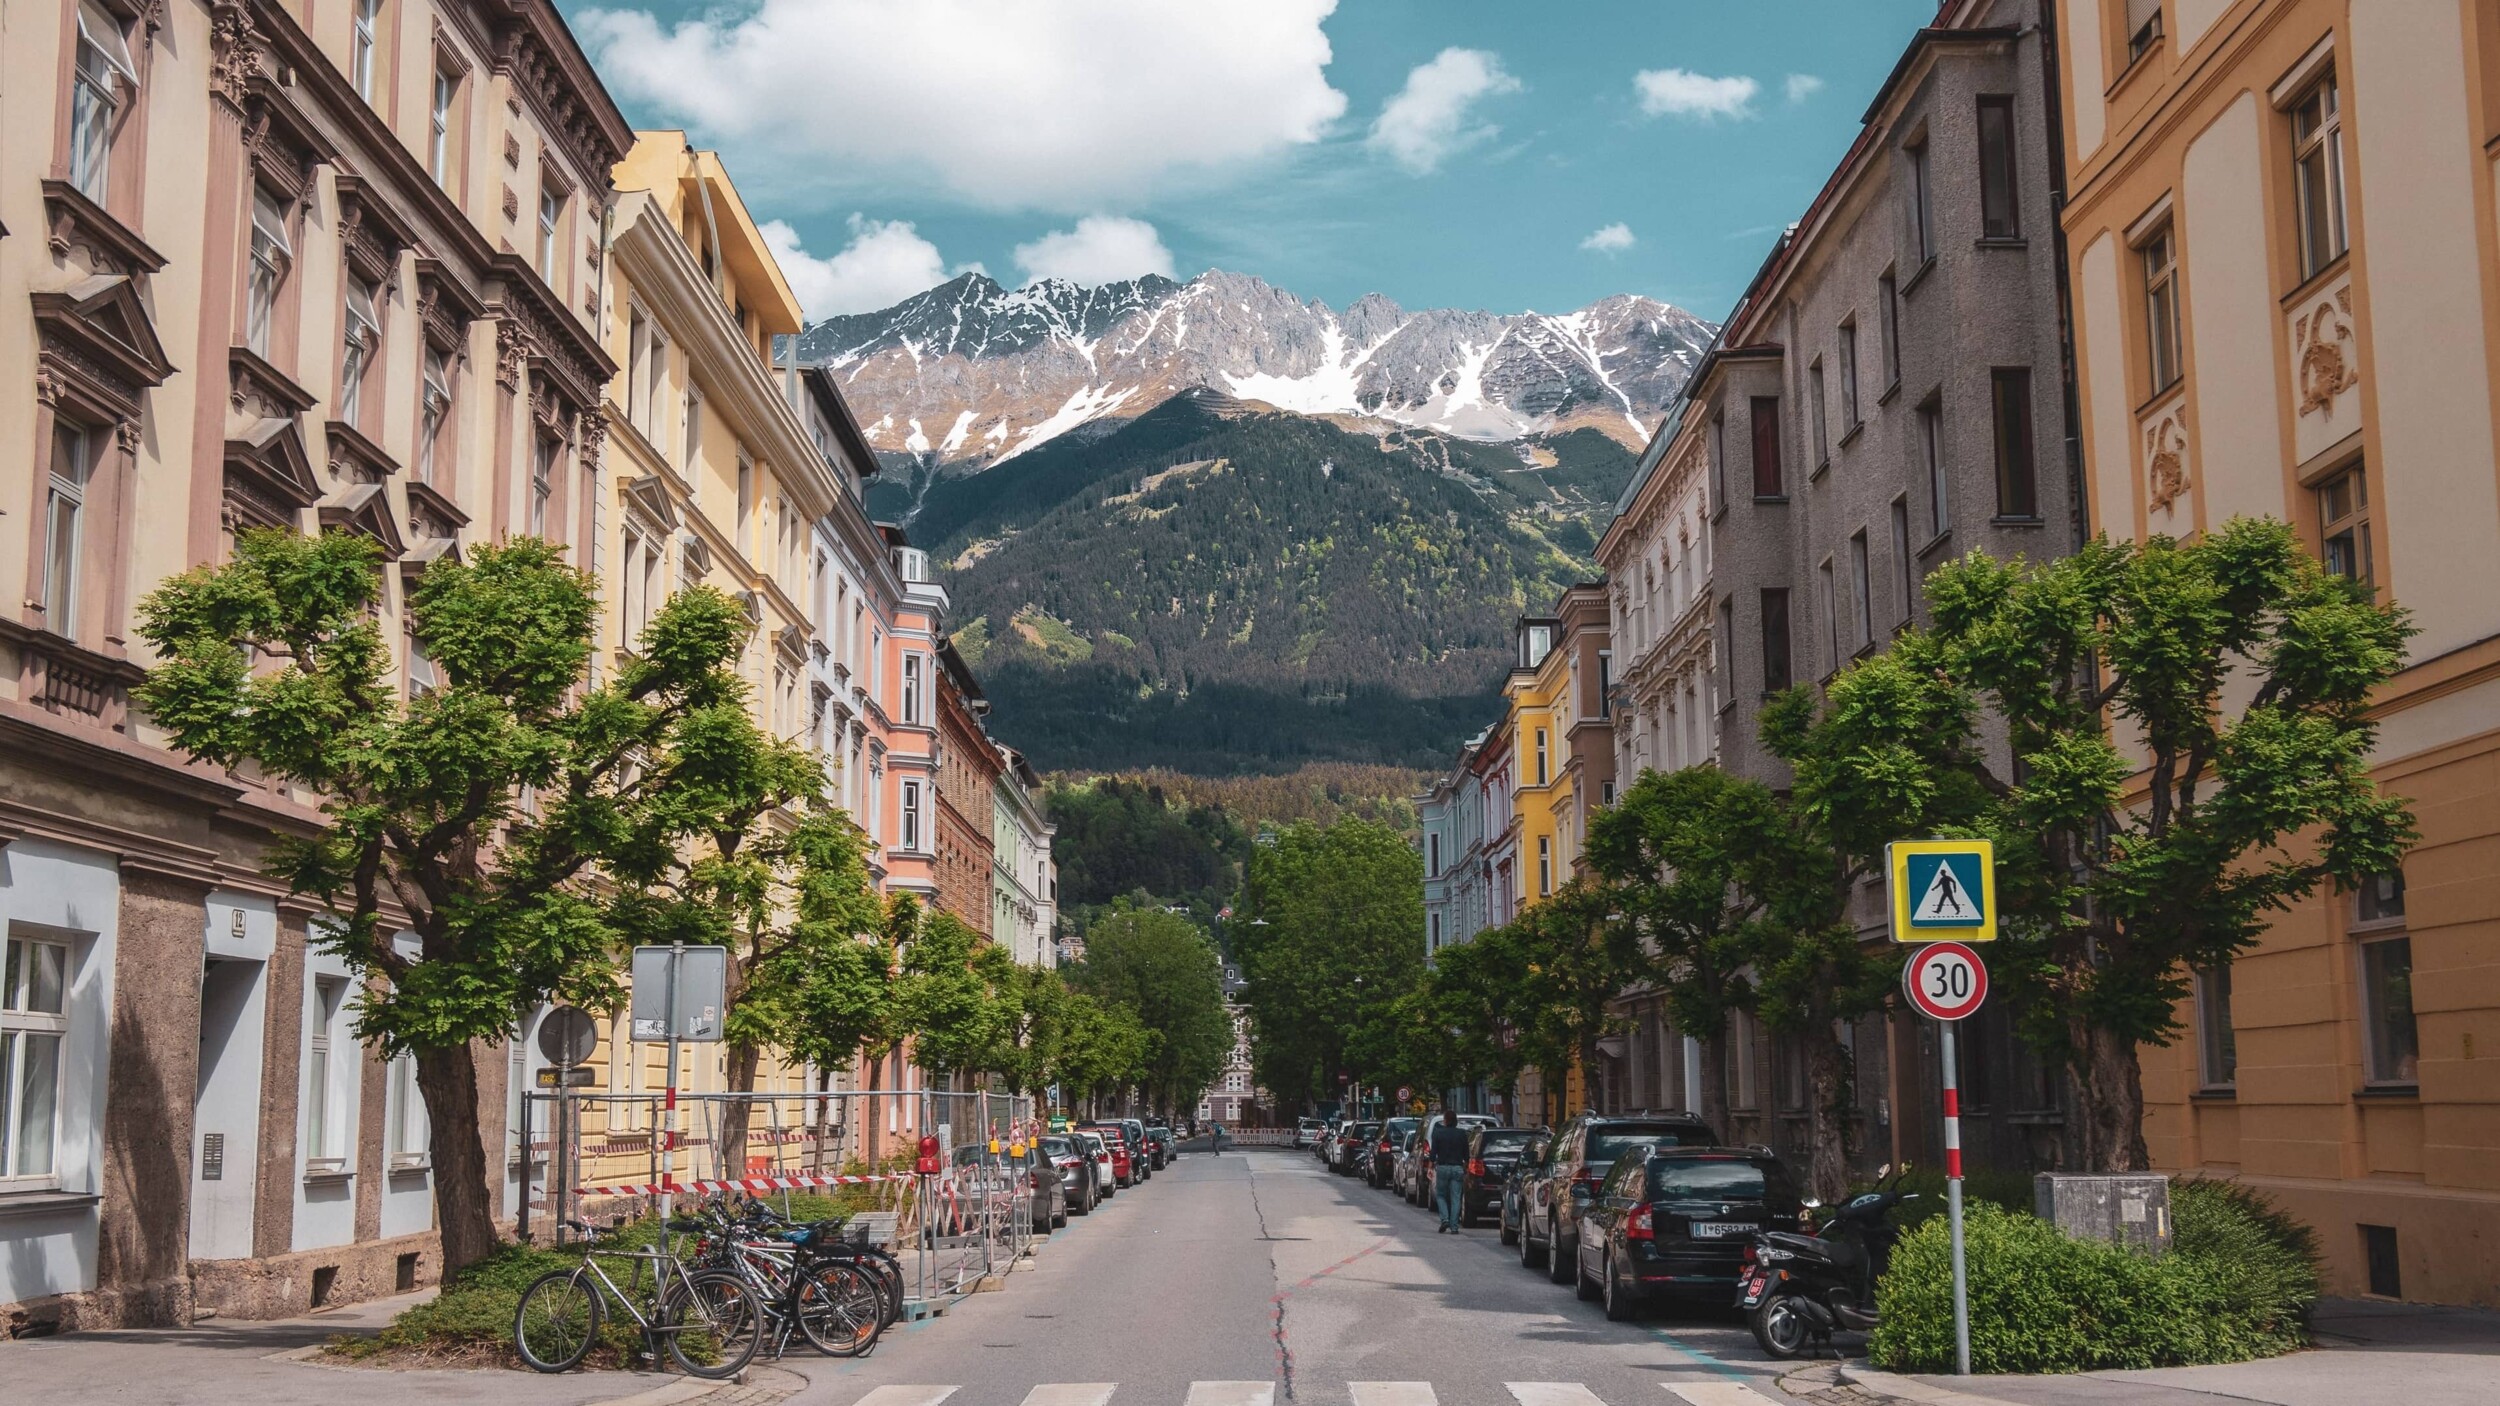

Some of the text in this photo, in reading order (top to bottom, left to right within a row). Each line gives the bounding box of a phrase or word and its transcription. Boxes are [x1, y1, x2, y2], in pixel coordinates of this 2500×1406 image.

[235, 911, 243, 928] 12
[1931, 962, 1968, 998] 30
[1400, 1090, 1408, 1098] 30
